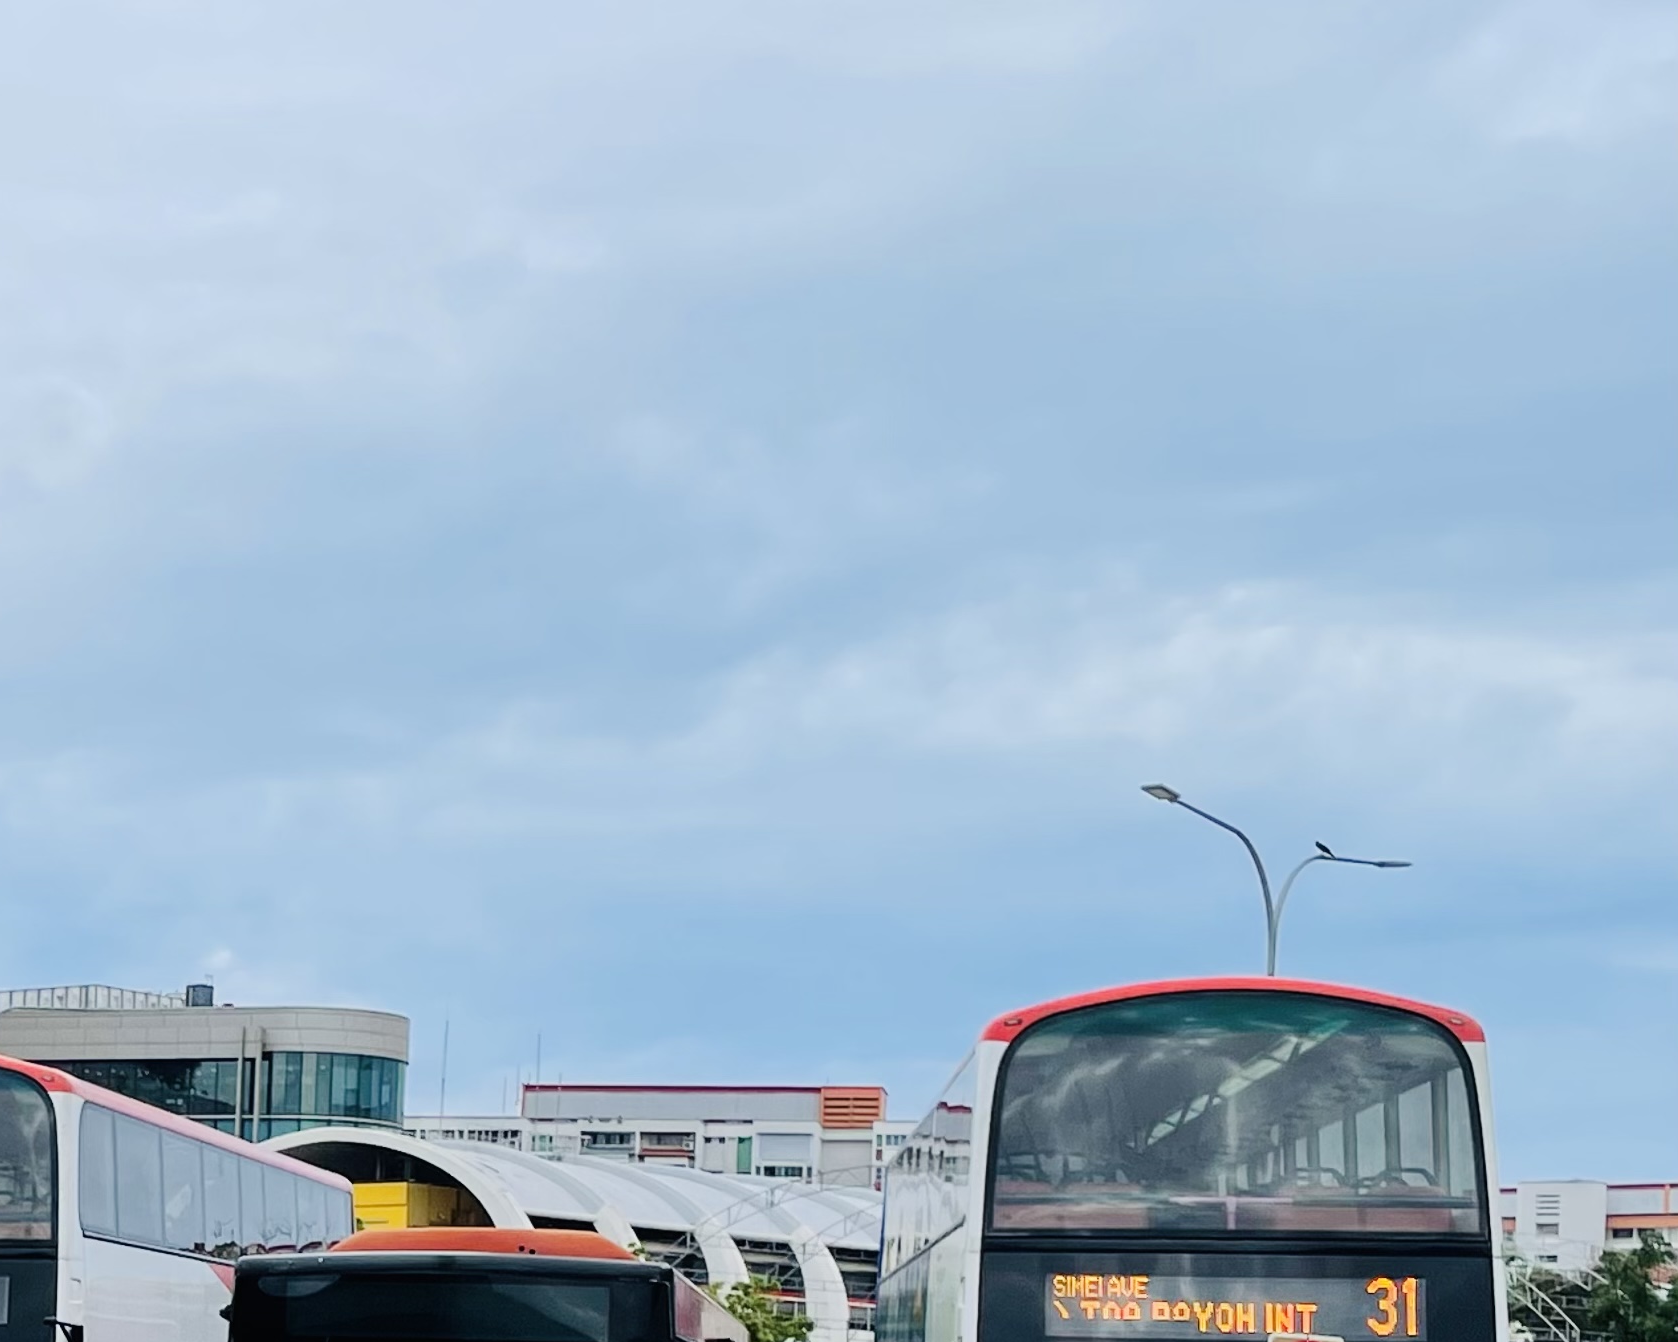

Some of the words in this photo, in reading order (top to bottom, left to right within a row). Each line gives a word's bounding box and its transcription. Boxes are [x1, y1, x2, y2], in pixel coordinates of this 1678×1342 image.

[1052, 1275, 1104, 1298] SIMEI
[1107, 1274, 1149, 1299] AVE
[1264, 1303, 1318, 1334] INT
[1365, 1276, 1419, 1337] 31
